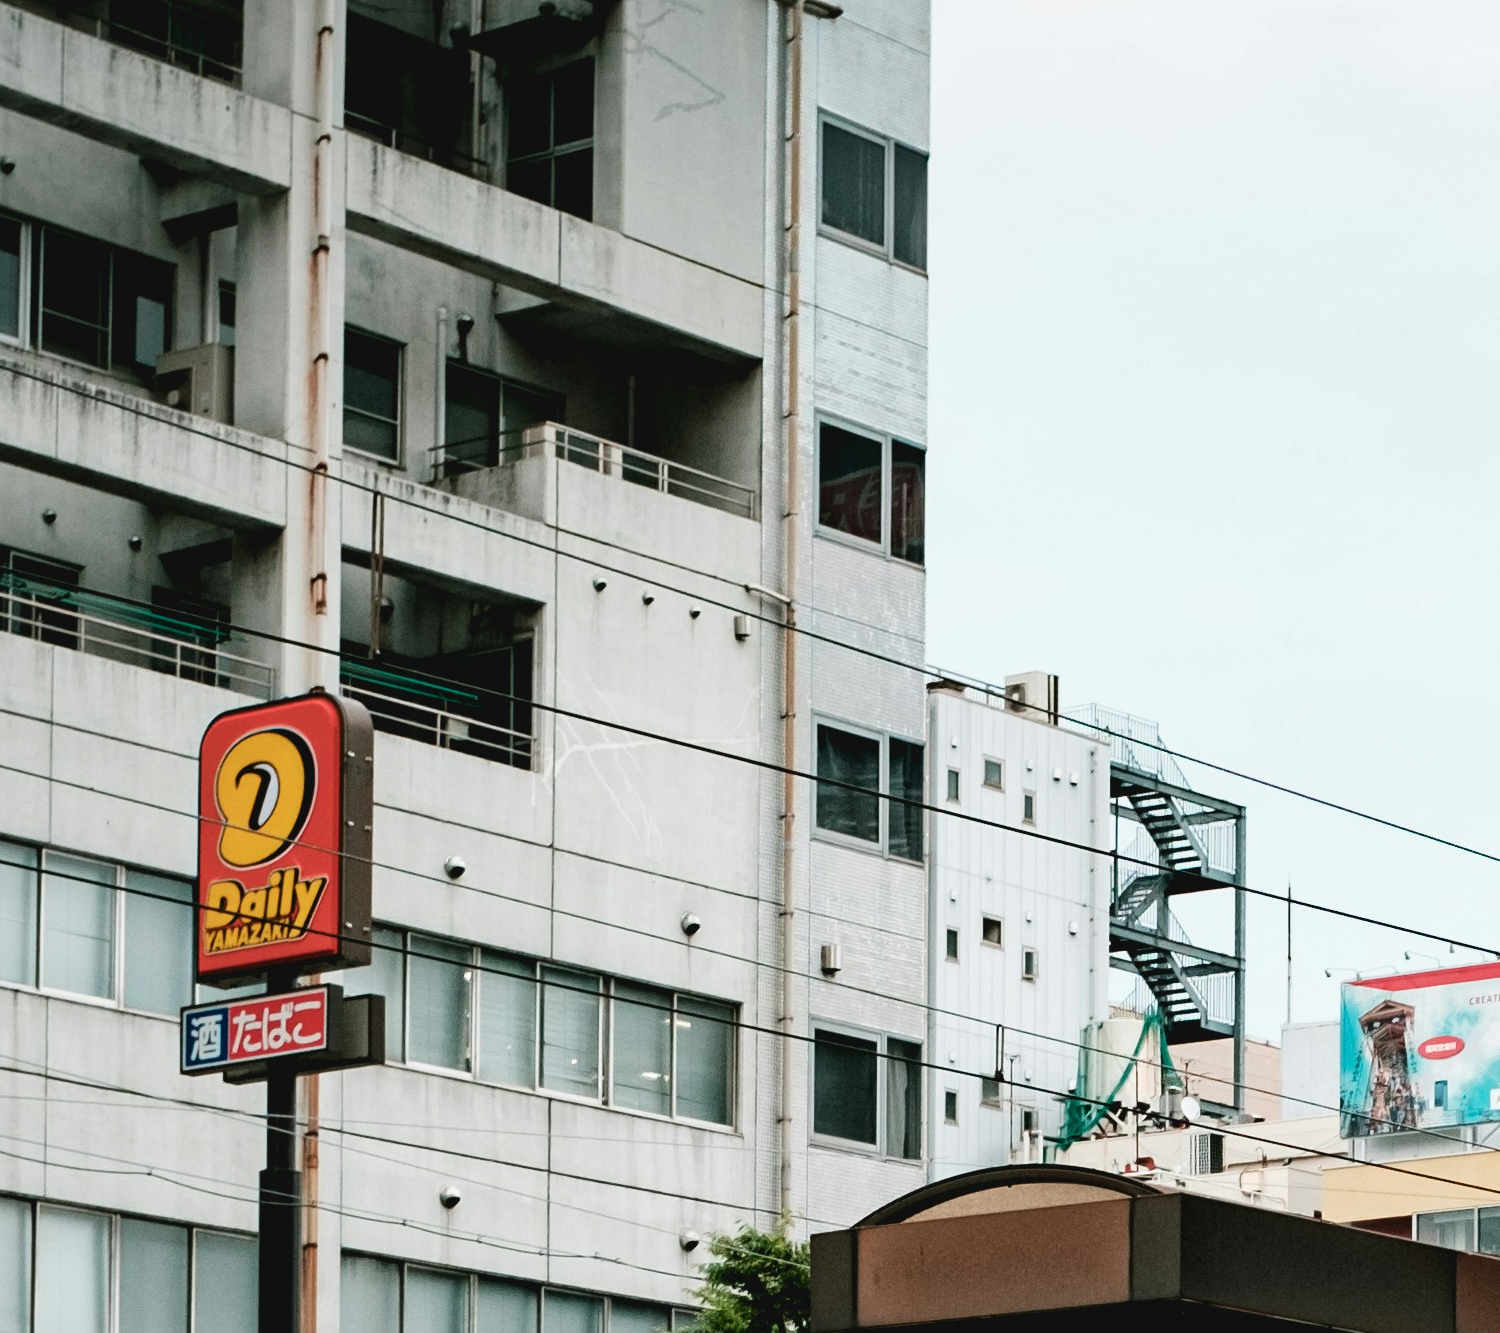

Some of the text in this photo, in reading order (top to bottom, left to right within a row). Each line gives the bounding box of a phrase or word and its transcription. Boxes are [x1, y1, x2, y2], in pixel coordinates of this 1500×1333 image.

[205, 867, 330, 938] Daily
[205, 920, 291, 953] YAMAZAKI
[190, 999, 322, 1061] 酒 たばこ
